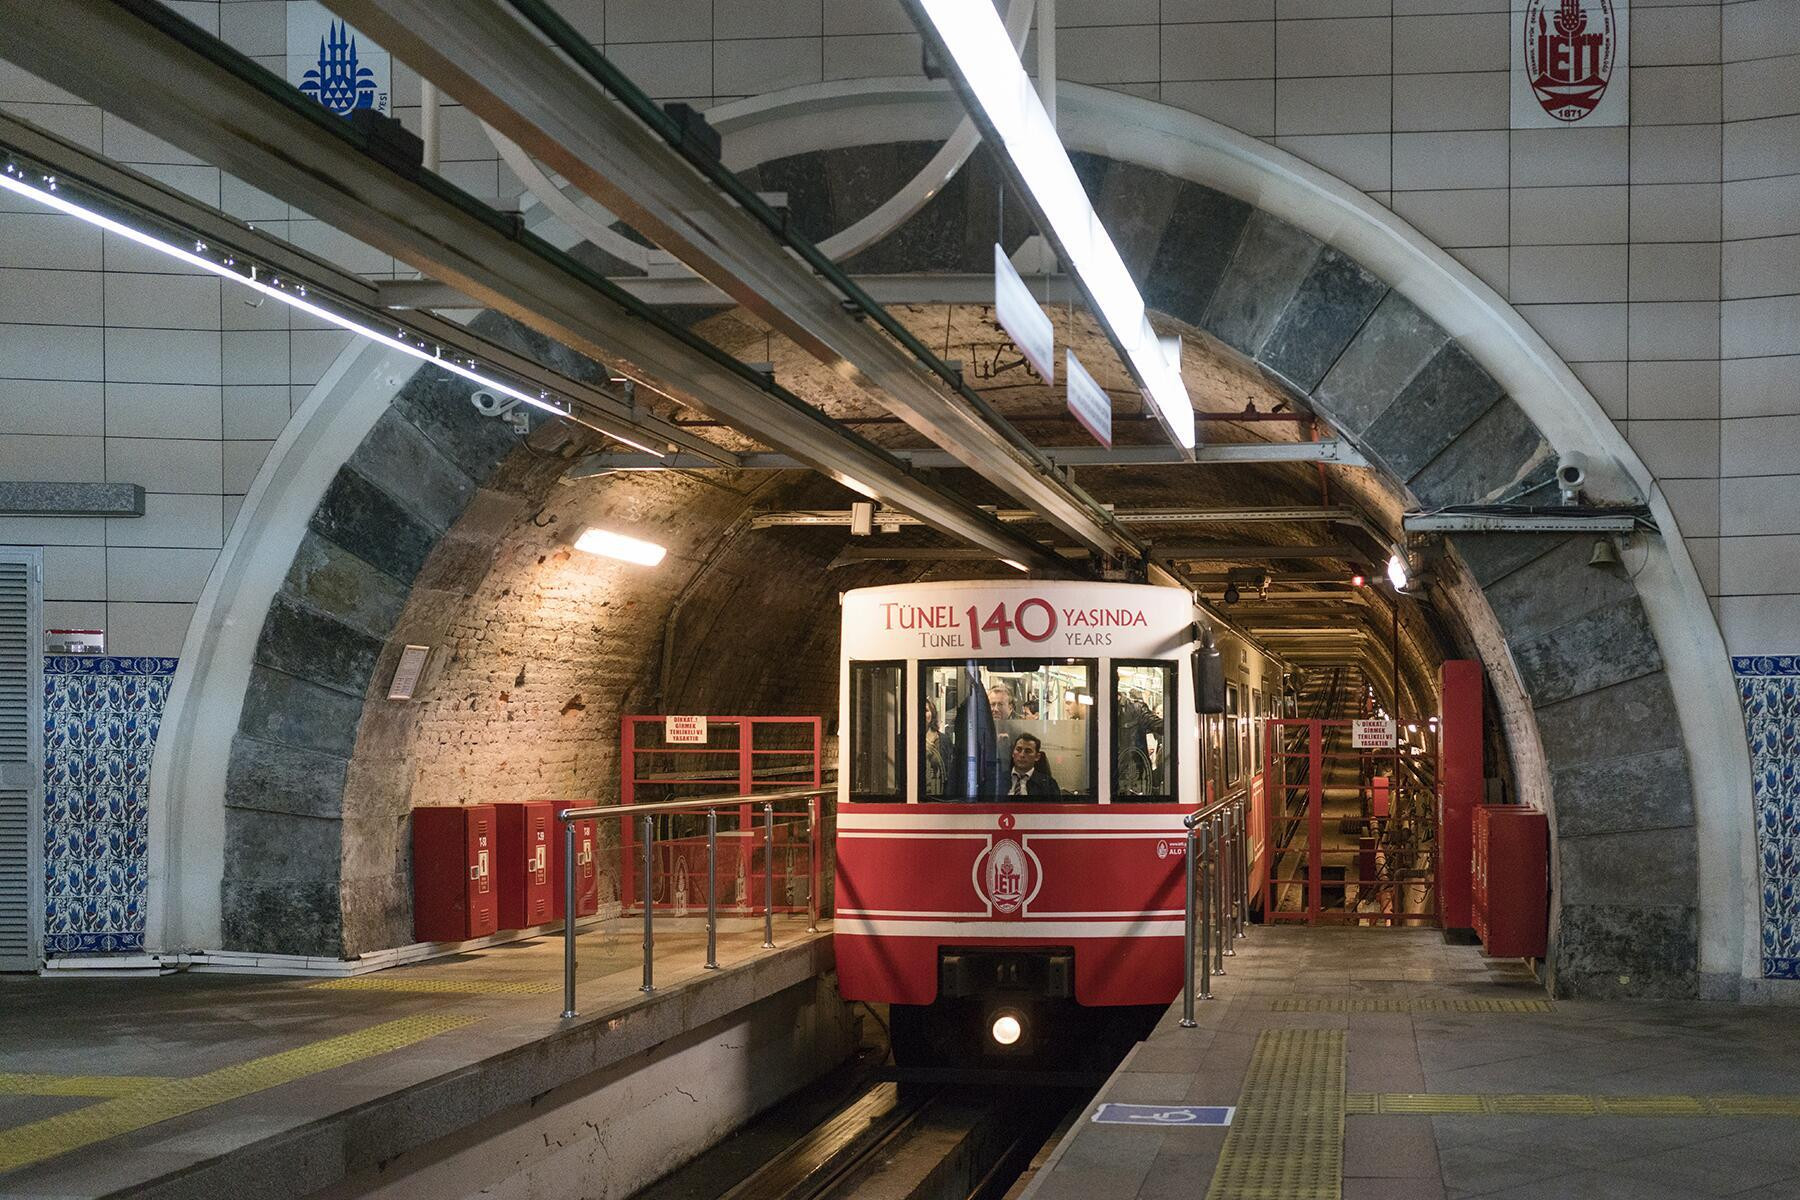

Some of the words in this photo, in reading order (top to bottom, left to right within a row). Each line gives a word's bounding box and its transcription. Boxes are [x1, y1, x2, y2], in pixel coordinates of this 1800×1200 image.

[1558, 109, 1582, 118] 1871
[879, 602, 960, 631] TÜNEL
[966, 597, 1058, 650] 140
[1063, 608, 1148, 629] YAŞINDA
[918, 631, 965, 648] TÜNEL
[1065, 632, 1113, 646] YEARS
[1003, 817, 1009, 827] 1
